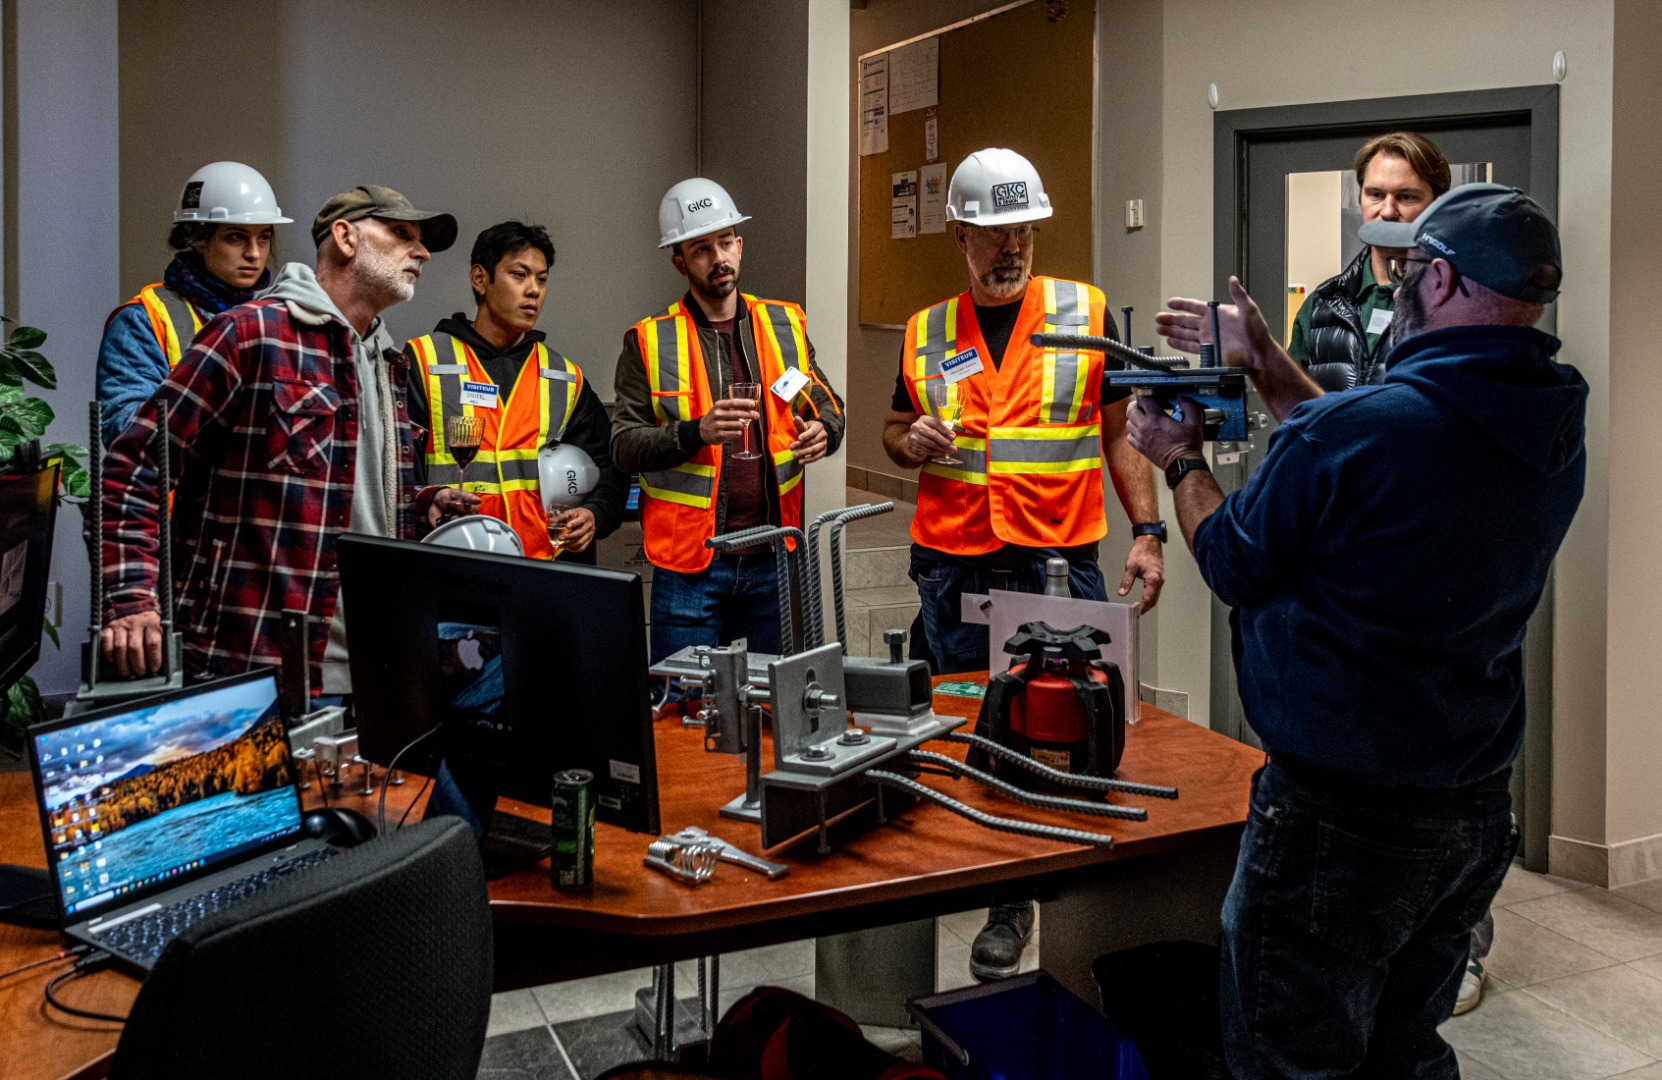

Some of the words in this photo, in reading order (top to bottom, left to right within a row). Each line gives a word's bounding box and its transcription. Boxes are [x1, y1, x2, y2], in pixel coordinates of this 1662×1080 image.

[996, 183, 1026, 197] GKC
[688, 198, 712, 213] GKC
[944, 351, 974, 367] VISITEUR
[466, 383, 495, 393] VISITEUR
[566, 469, 578, 495] GKC
